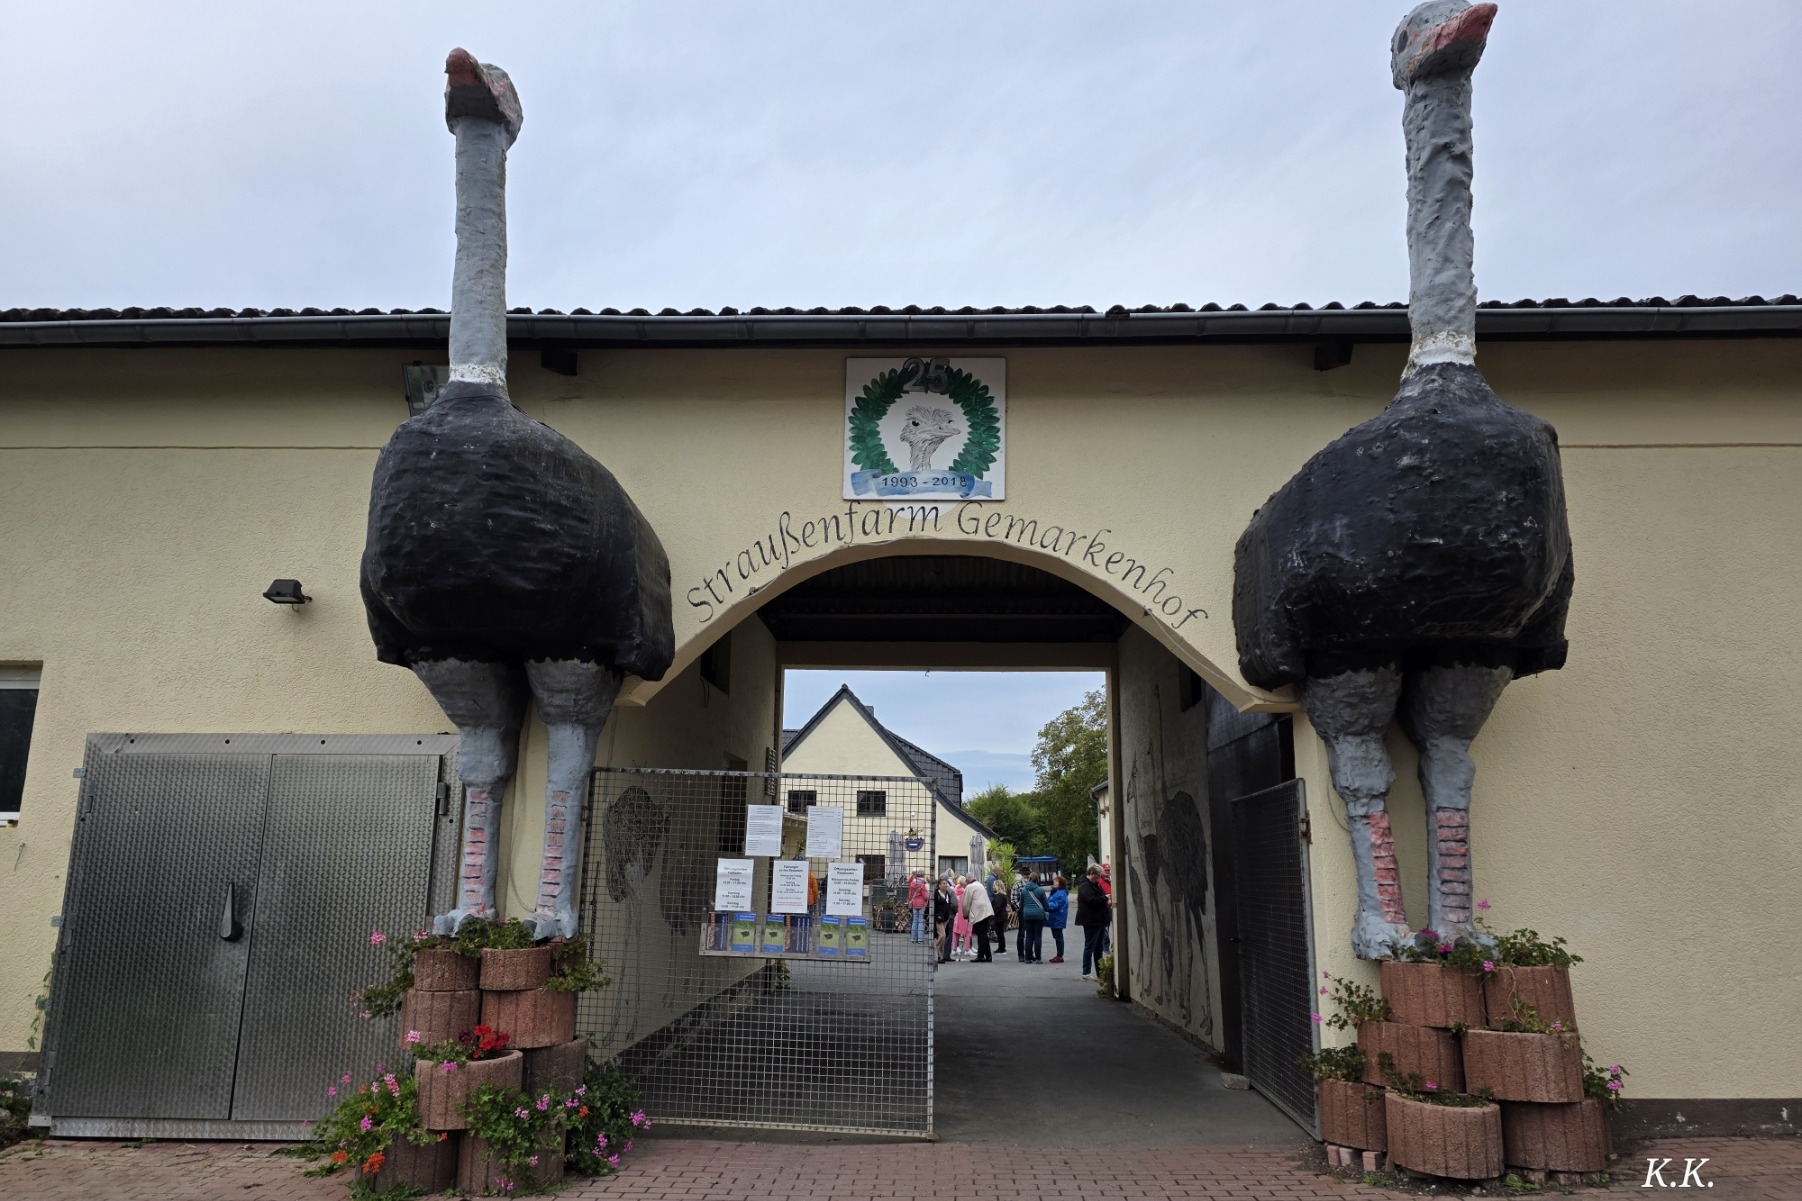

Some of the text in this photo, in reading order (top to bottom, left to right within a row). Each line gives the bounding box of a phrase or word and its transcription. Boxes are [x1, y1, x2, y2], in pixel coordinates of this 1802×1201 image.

[902, 357, 950, 394] 25
[882, 476, 918, 488] 1993
[932, 476, 967, 488] 2018
[687, 500, 1209, 629] Straußenfarm Gemarkenhof
